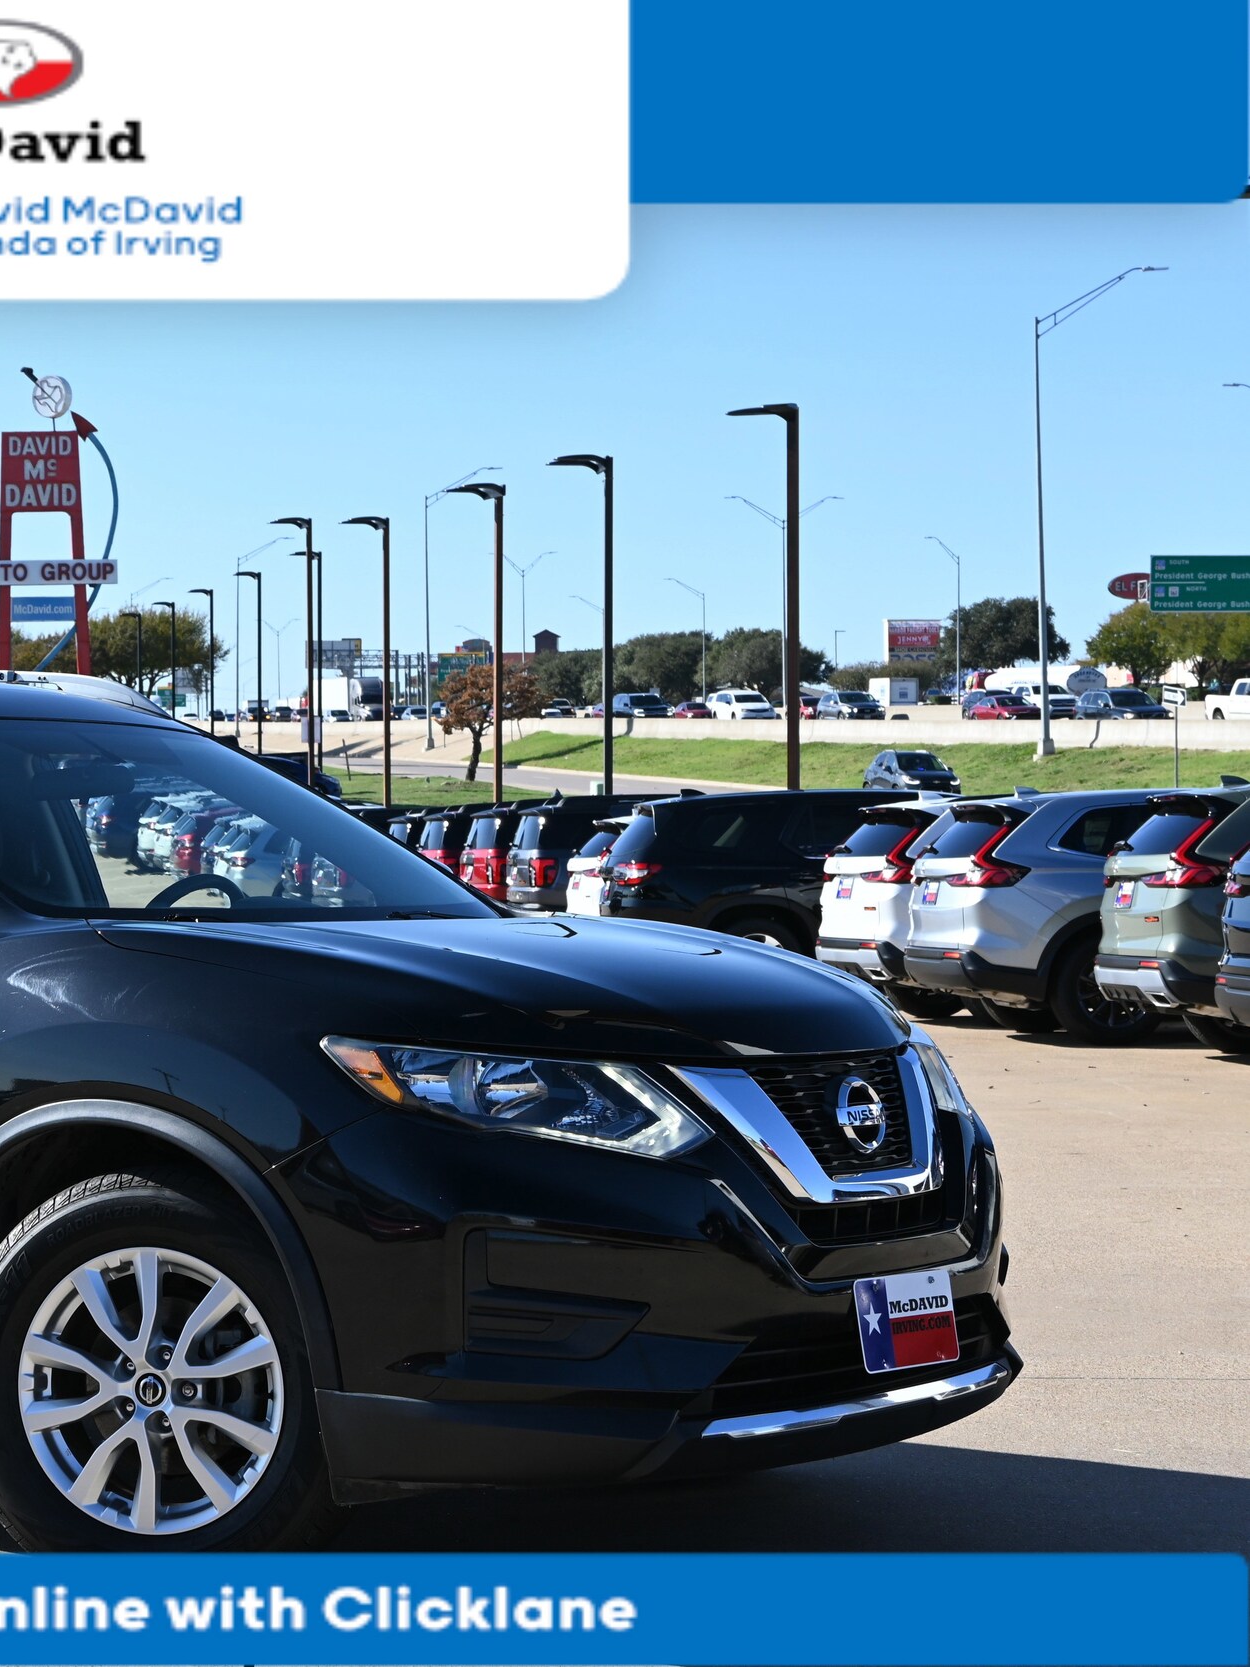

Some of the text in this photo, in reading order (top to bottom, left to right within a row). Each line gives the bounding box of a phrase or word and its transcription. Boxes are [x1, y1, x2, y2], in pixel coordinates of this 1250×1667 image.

[8, 435, 72, 457] DAVID
[4, 483, 77, 507] DAVID
[40, 562, 114, 582] GROUP
[1154, 572, 1194, 580] President
[1197, 573, 1227, 581] George
[13, 603, 73, 615] McDavid.com
[1153, 601, 1193, 609] President
[1196, 601, 1226, 609] George
[888, 1294, 949, 1315] McDAVID
[891, 1315, 951, 1335] IRVING.COM
